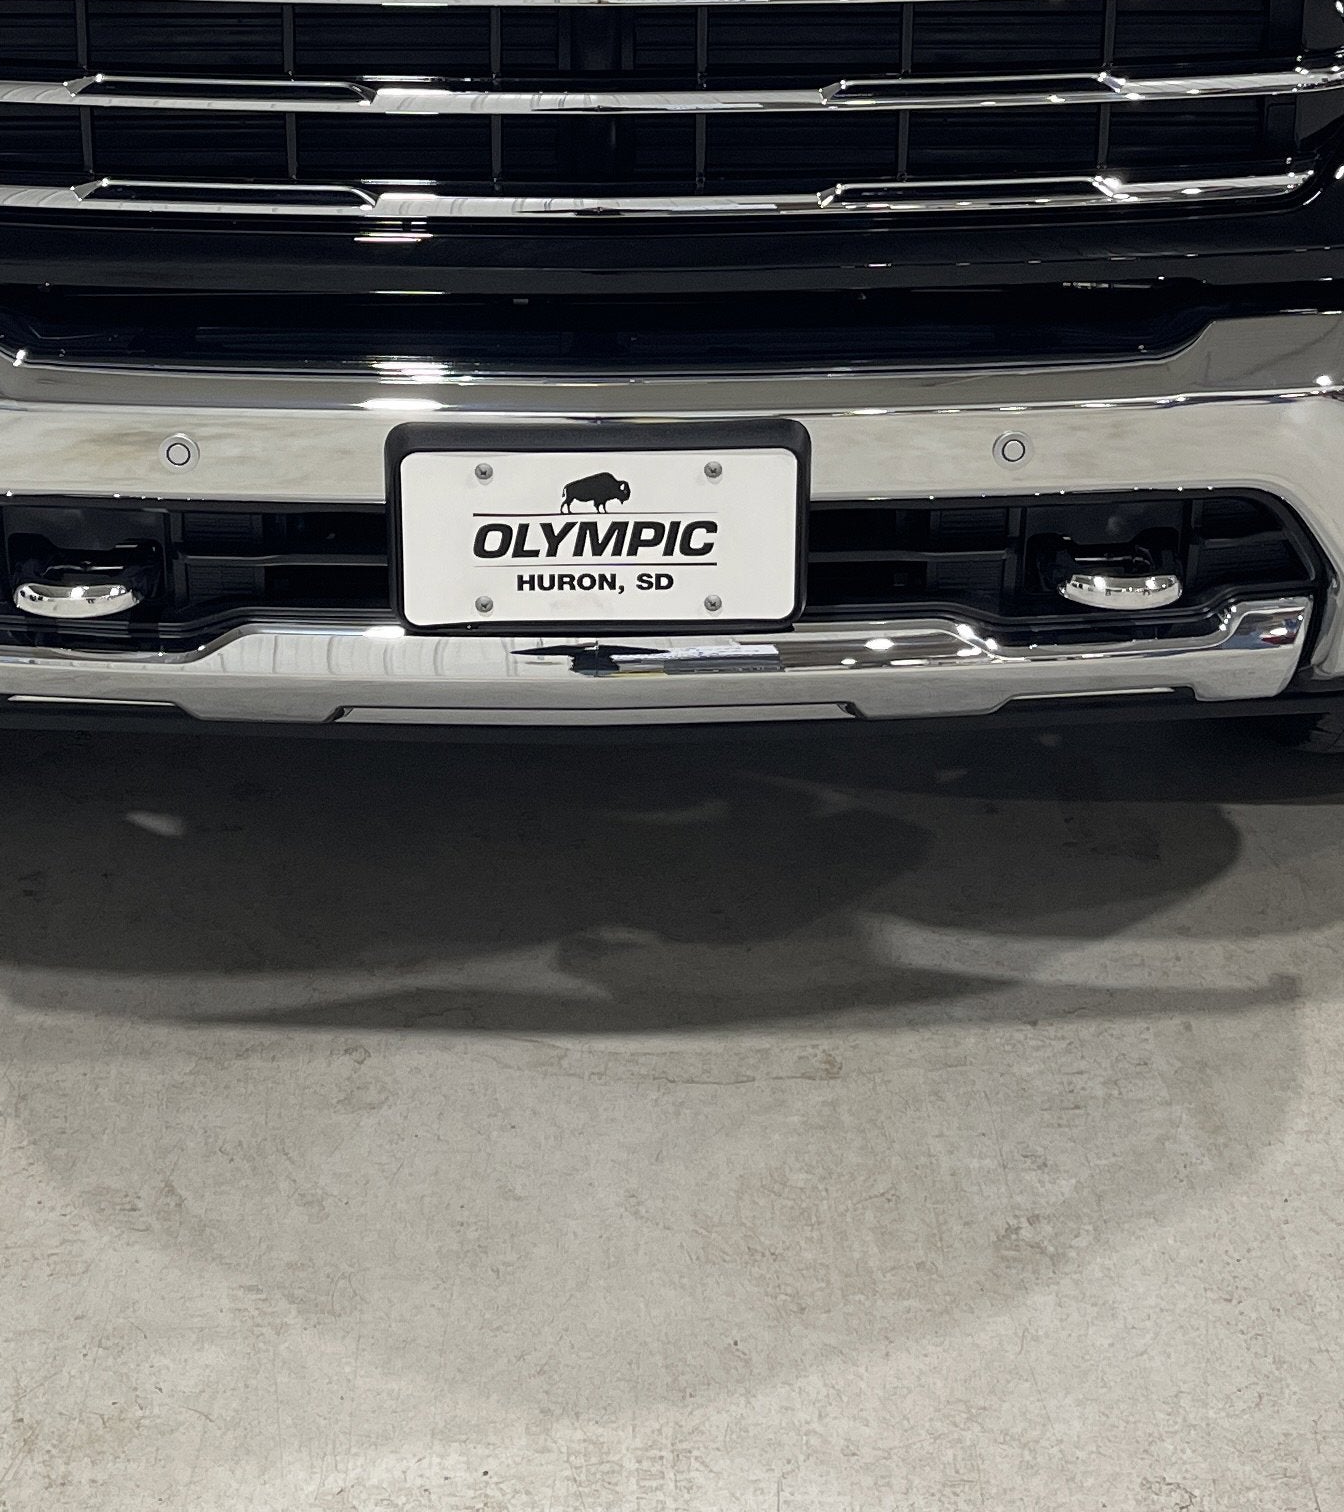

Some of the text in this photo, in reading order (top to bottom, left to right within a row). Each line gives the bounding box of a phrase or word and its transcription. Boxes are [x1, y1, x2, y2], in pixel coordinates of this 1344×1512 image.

[473, 520, 718, 559] OLYMPIC
[516, 573, 675, 595] HURON, SD
